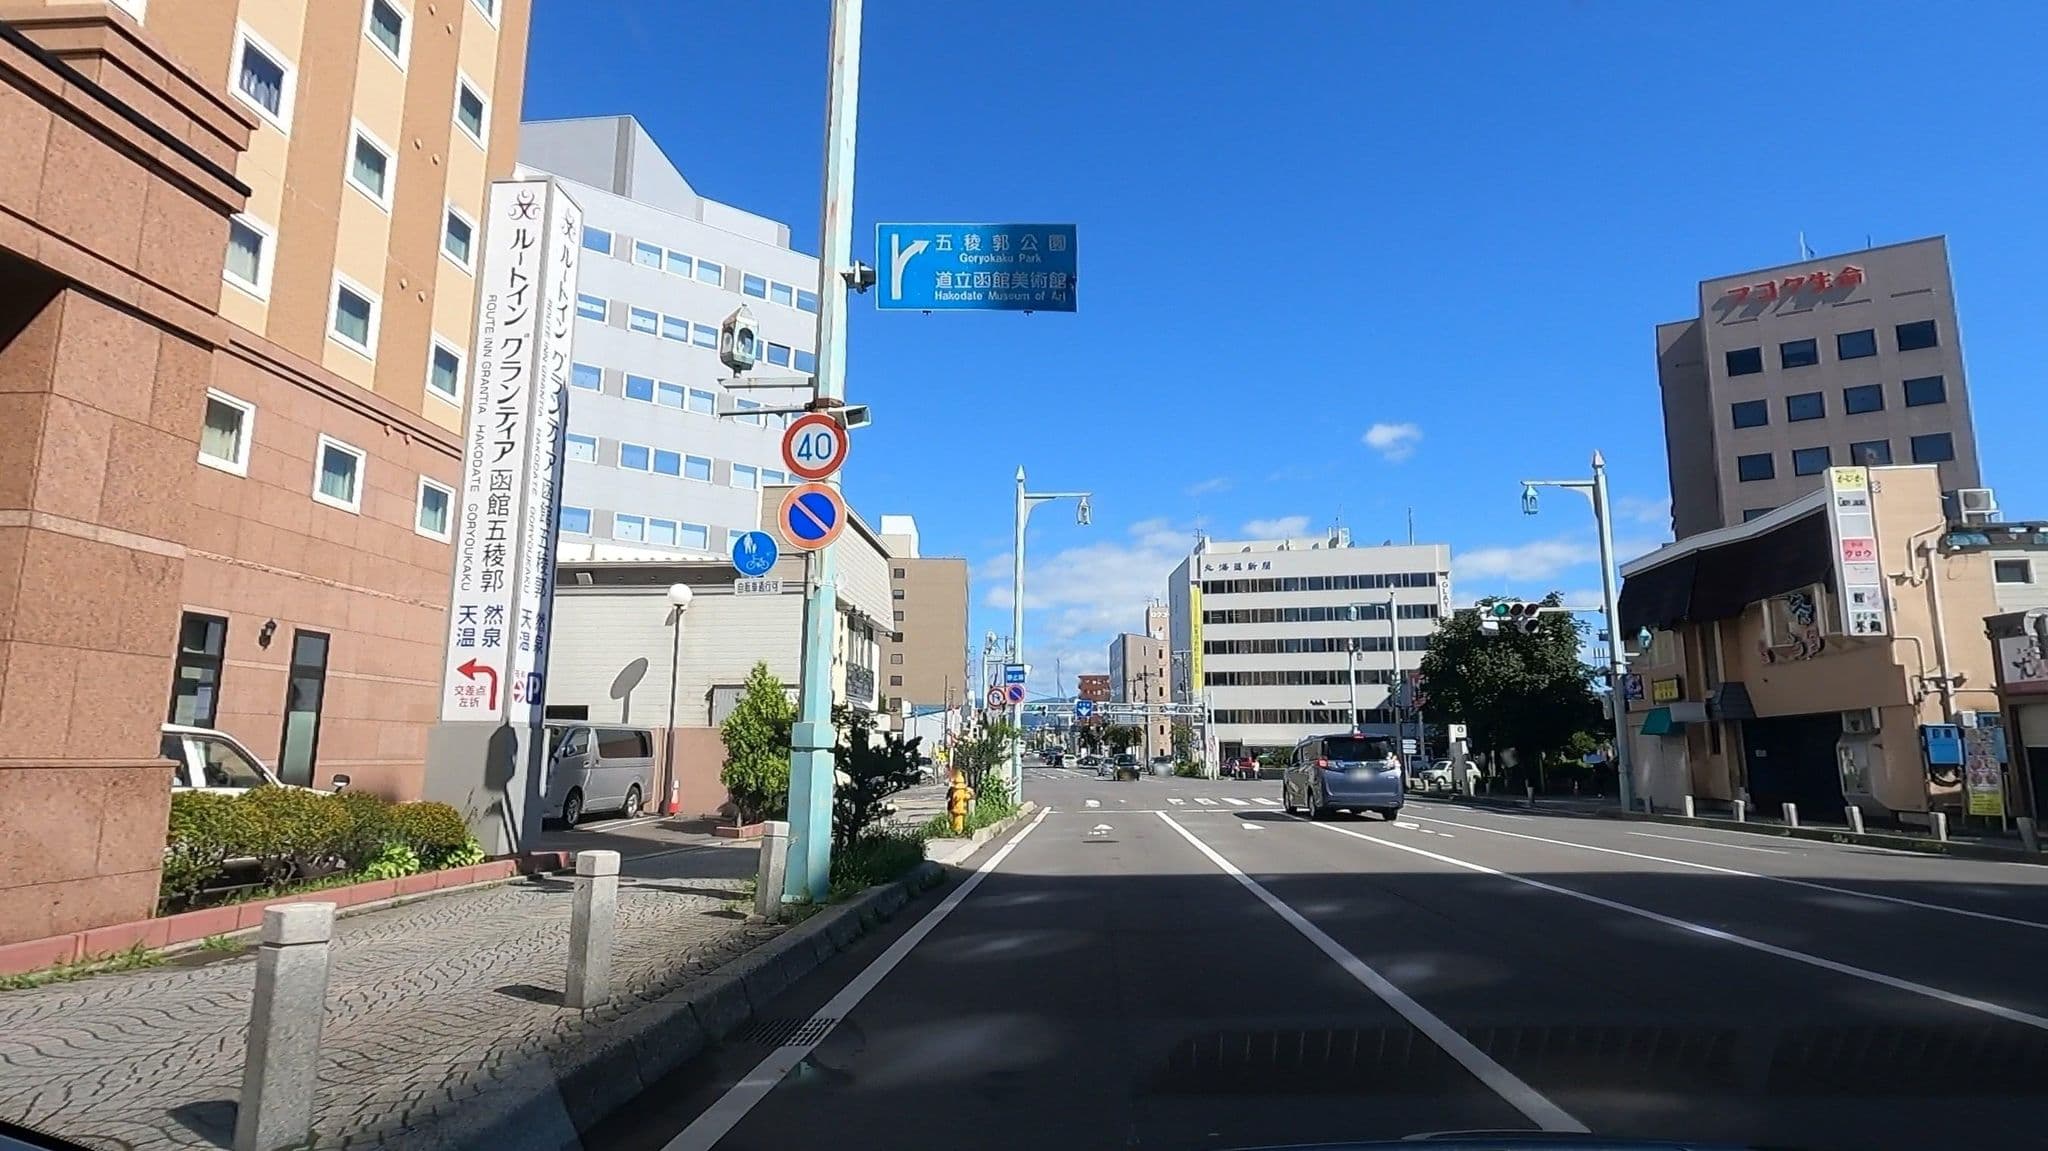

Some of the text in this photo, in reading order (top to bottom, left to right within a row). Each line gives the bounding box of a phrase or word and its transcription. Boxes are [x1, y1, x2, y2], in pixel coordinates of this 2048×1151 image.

[935, 234, 1066, 252] 五稜郭公園
[959, 253, 1041, 264] Goryokaku Park
[935, 271, 1067, 289] 道立函館美術館
[935, 291, 1066, 301] Hakodate Museum of Art
[480, 228, 536, 593] ルートイン グランティア 函館五稜郭
[461, 294, 498, 591] ROUTE INN GRANTIA HAKODATE GORYOUKAKU
[797, 432, 832, 461] 40
[454, 685, 487, 696] 交差点
[459, 697, 479, 707] 左折
